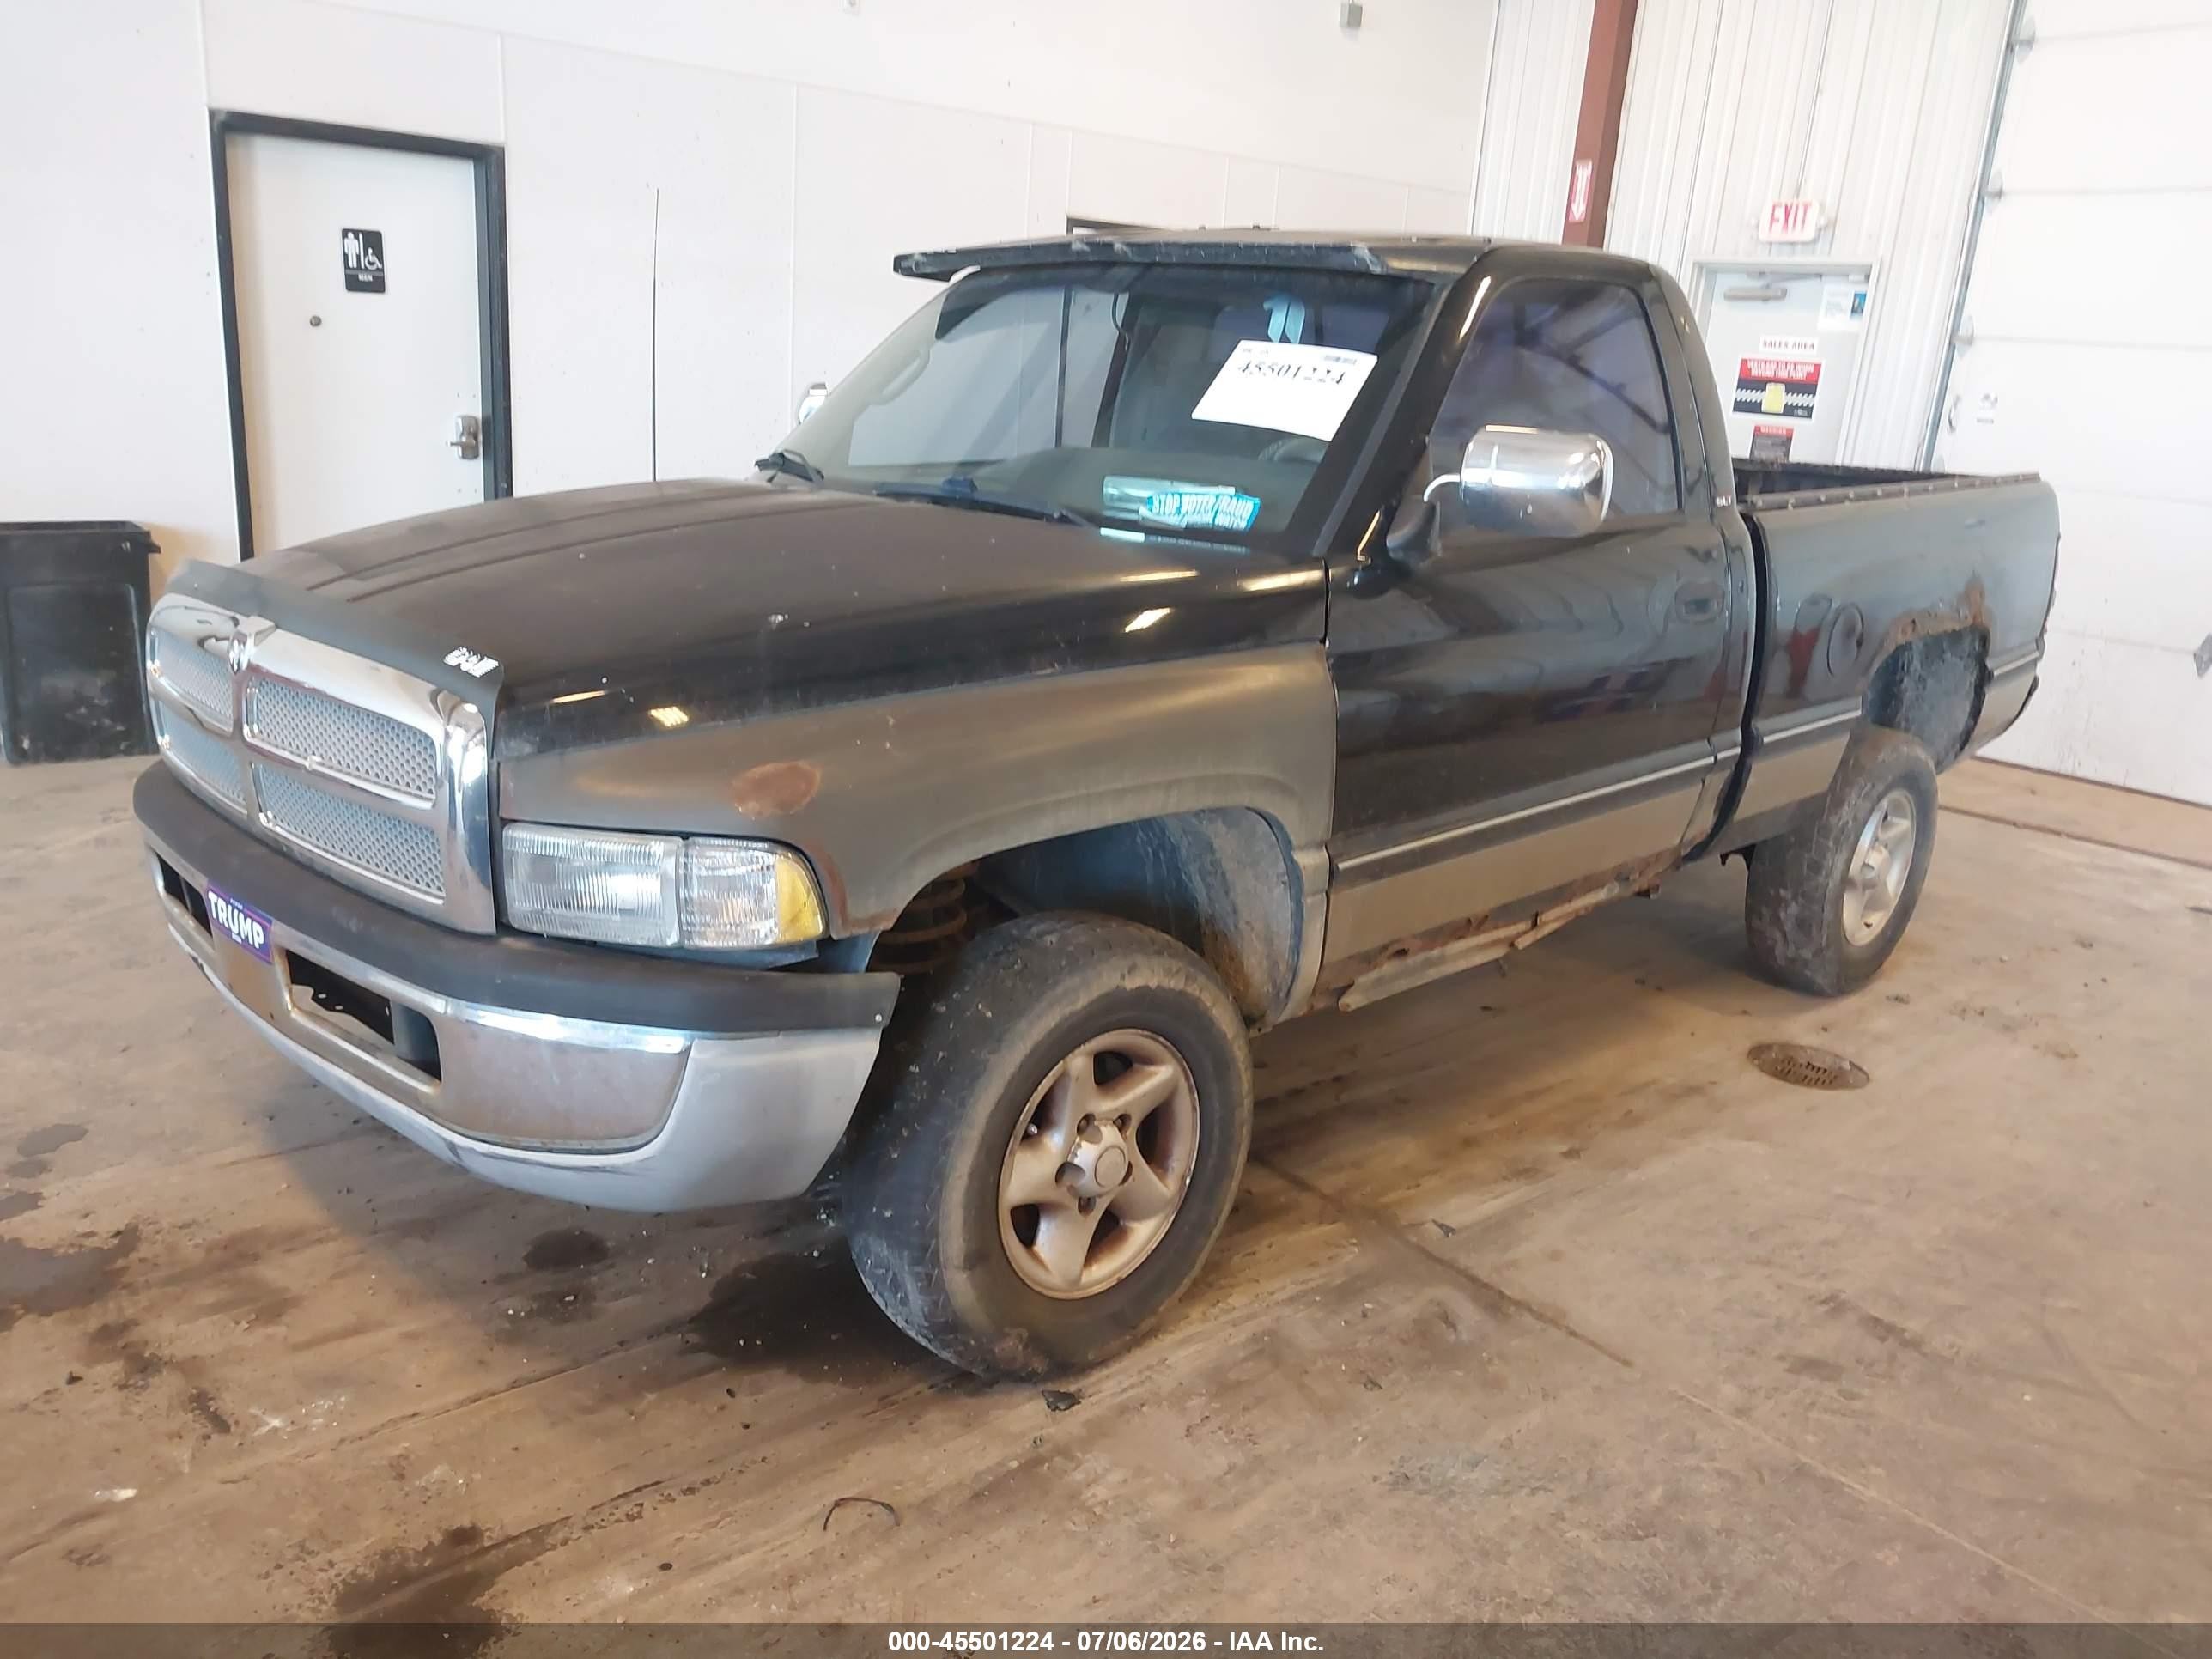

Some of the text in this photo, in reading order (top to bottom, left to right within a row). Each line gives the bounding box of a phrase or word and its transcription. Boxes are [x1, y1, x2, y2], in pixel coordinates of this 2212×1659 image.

[1768, 199, 1812, 234] EXIT
[1763, 339, 1814, 350] SALES AREA
[1237, 360, 1346, 385] 45501224
[1152, 493, 1181, 515] STOP
[208, 890, 264, 950] TRUMP
